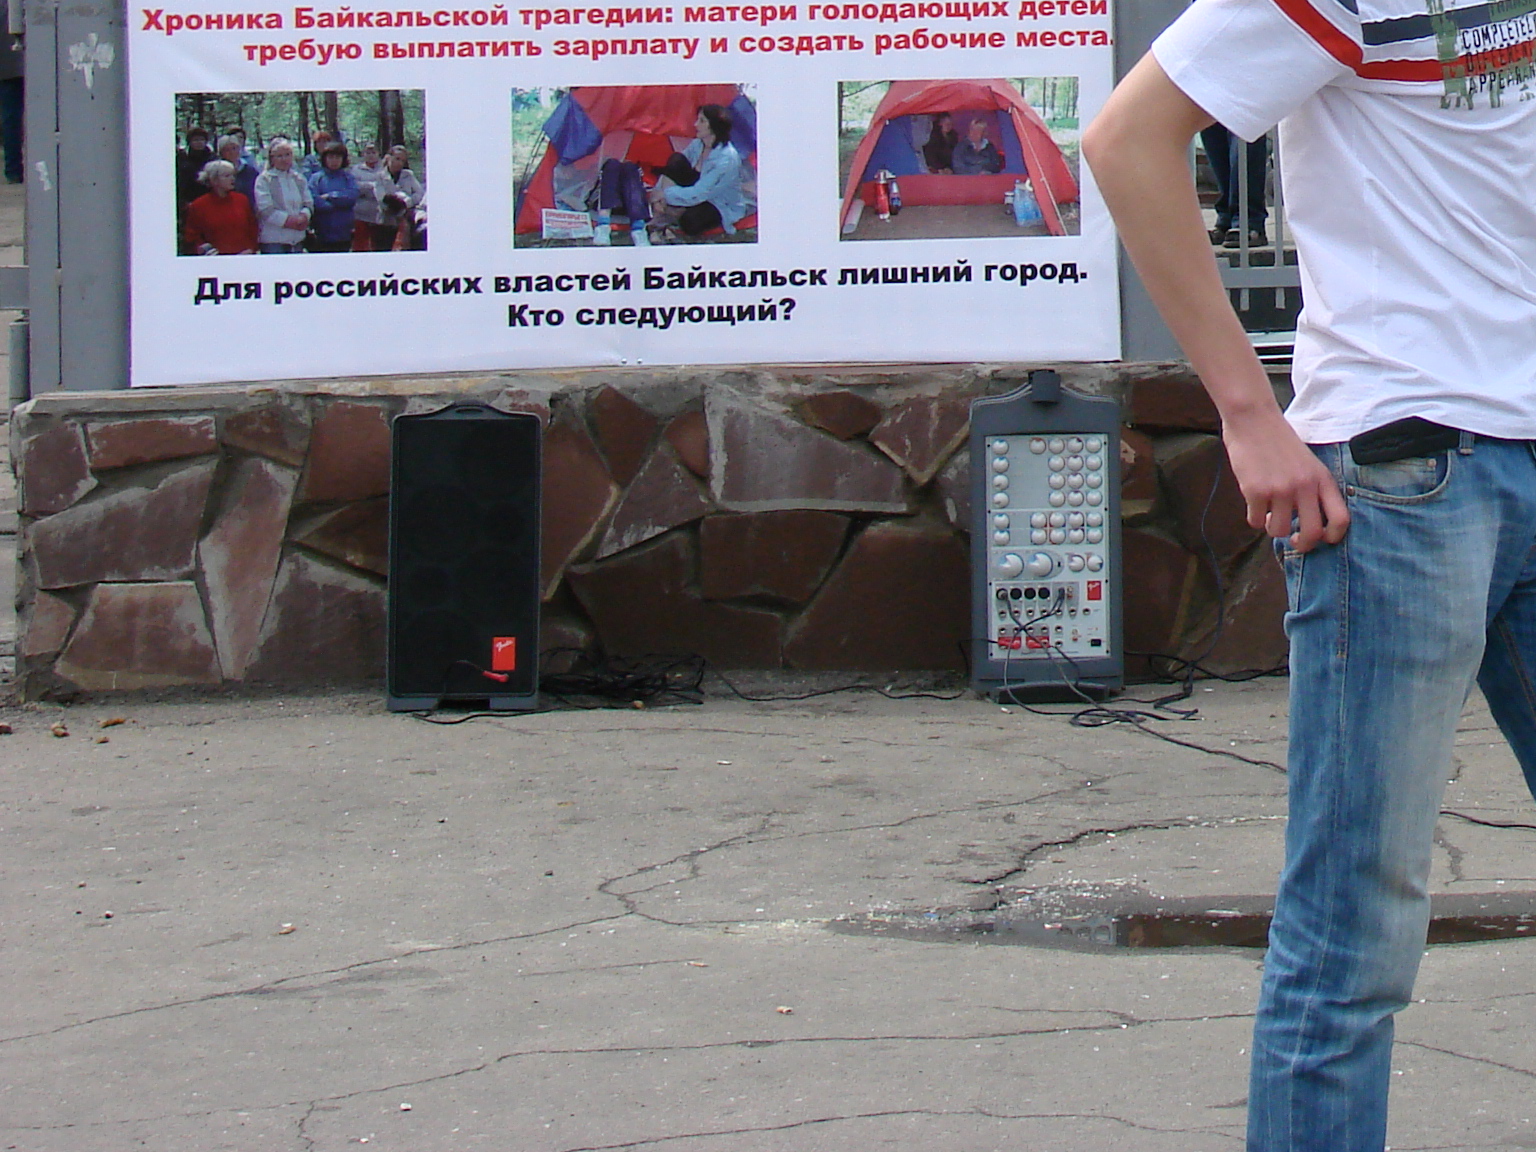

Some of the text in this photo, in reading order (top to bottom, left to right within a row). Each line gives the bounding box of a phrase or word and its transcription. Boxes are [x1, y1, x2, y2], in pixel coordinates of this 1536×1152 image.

[143, 10, 282, 35] Хроника
[296, 5, 508, 28] Байкальской
[520, 8, 672, 30] трагедии:
[685, 6, 796, 26] матери
[809, 2, 1008, 22] голодающих
[244, 39, 362, 66] требую
[374, 41, 541, 58] выплатить
[554, 38, 699, 60] зарплату
[711, 38, 727, 52] и
[740, 36, 863, 55] создать
[876, 28, 1005, 54] рабочие
[195, 260, 1087, 305] Для российских властей Байкальск лишний город.
[509, 298, 795, 329] Кто следующий?
